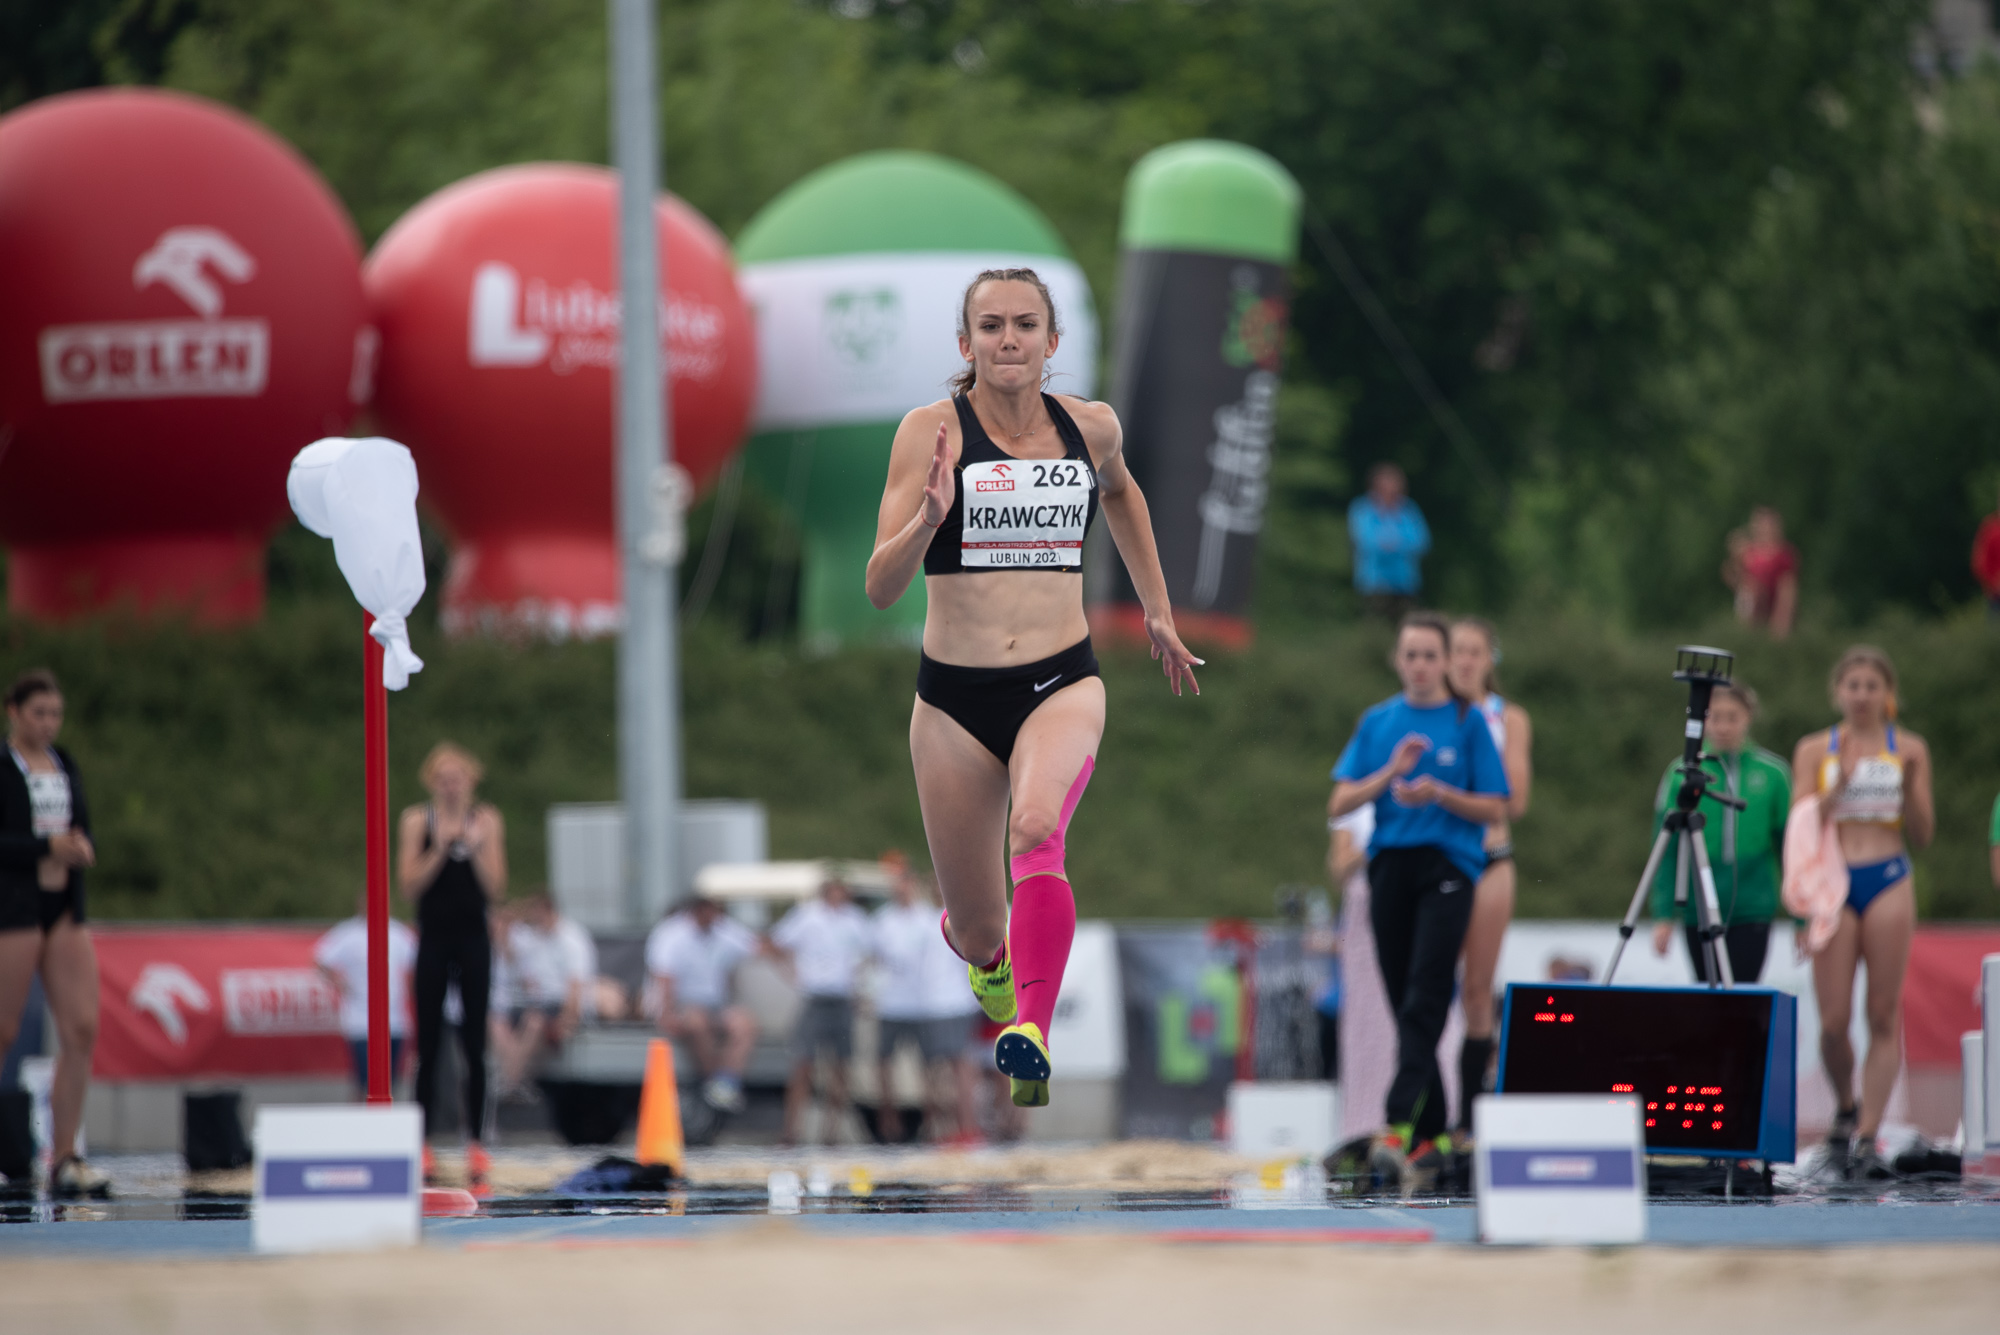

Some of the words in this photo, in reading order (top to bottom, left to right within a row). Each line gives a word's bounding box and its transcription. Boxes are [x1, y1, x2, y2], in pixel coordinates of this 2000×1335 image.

[56, 341, 250, 387] ORLEN
[977, 481, 1014, 491] ORLEN
[1032, 464, 1082, 488] 262
[969, 504, 1084, 529] KRAWCZYK
[989, 552, 1031, 564] LUBLIN
